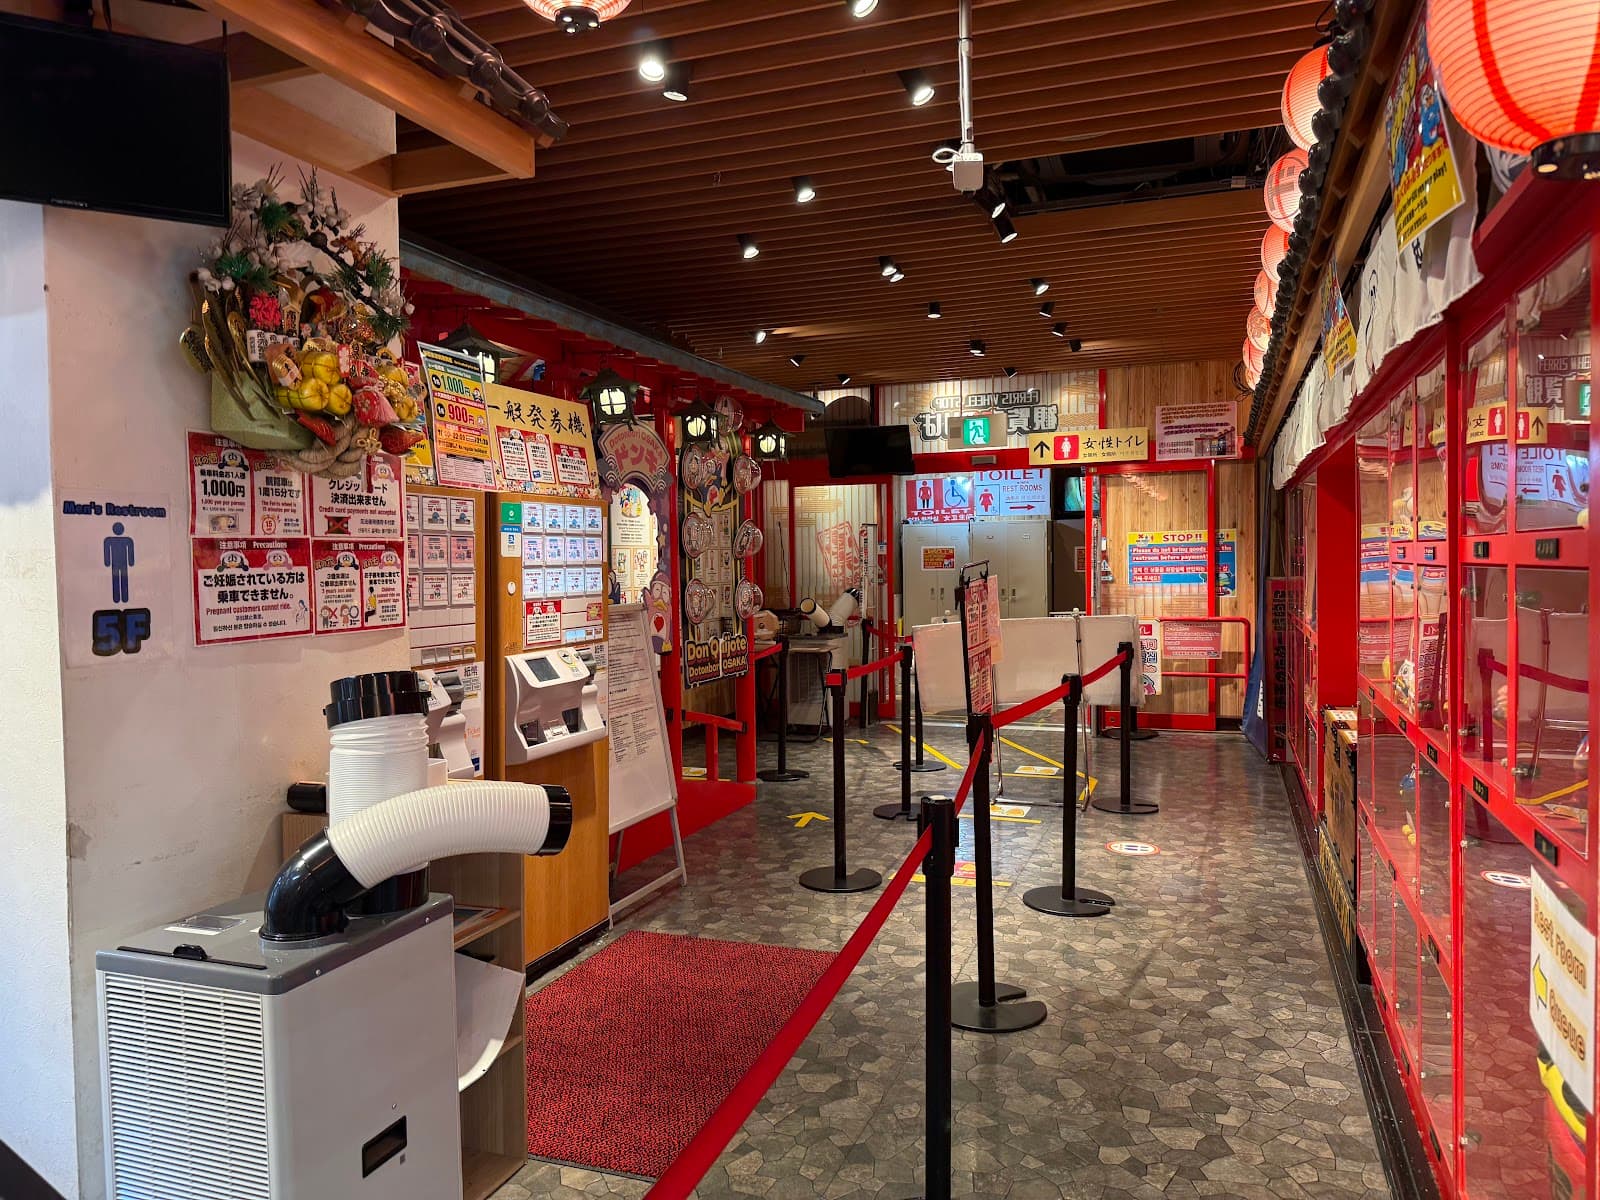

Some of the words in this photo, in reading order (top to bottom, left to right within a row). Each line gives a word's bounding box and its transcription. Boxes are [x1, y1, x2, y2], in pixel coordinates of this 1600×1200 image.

[1083, 435, 1144, 450] 女性トイレ
[980, 469, 1043, 482] TOILET
[202, 480, 245, 498] 1,000円
[259, 487, 301, 499] 1周15分です
[328, 480, 388, 494] クレジッード
[331, 493, 386, 507] 決済出来ません
[63, 501, 102, 515] Men's
[106, 503, 166, 518] Restroom
[911, 508, 971, 516] TOILET
[1172, 546, 1187, 554] bring
[203, 572, 305, 587] ご妊娠されている方は
[217, 588, 293, 603] 乗車できません。
[206, 606, 232, 616] Pregnant
[233, 604, 260, 613] customers
[261, 603, 279, 611] cannot
[92, 608, 151, 656] 5F
[687, 643, 709, 661] Don
[722, 656, 746, 670] OSAKA
[1534, 898, 1554, 948] Rest
[1556, 933, 1586, 989] room
[1549, 989, 1585, 1061] Queue
